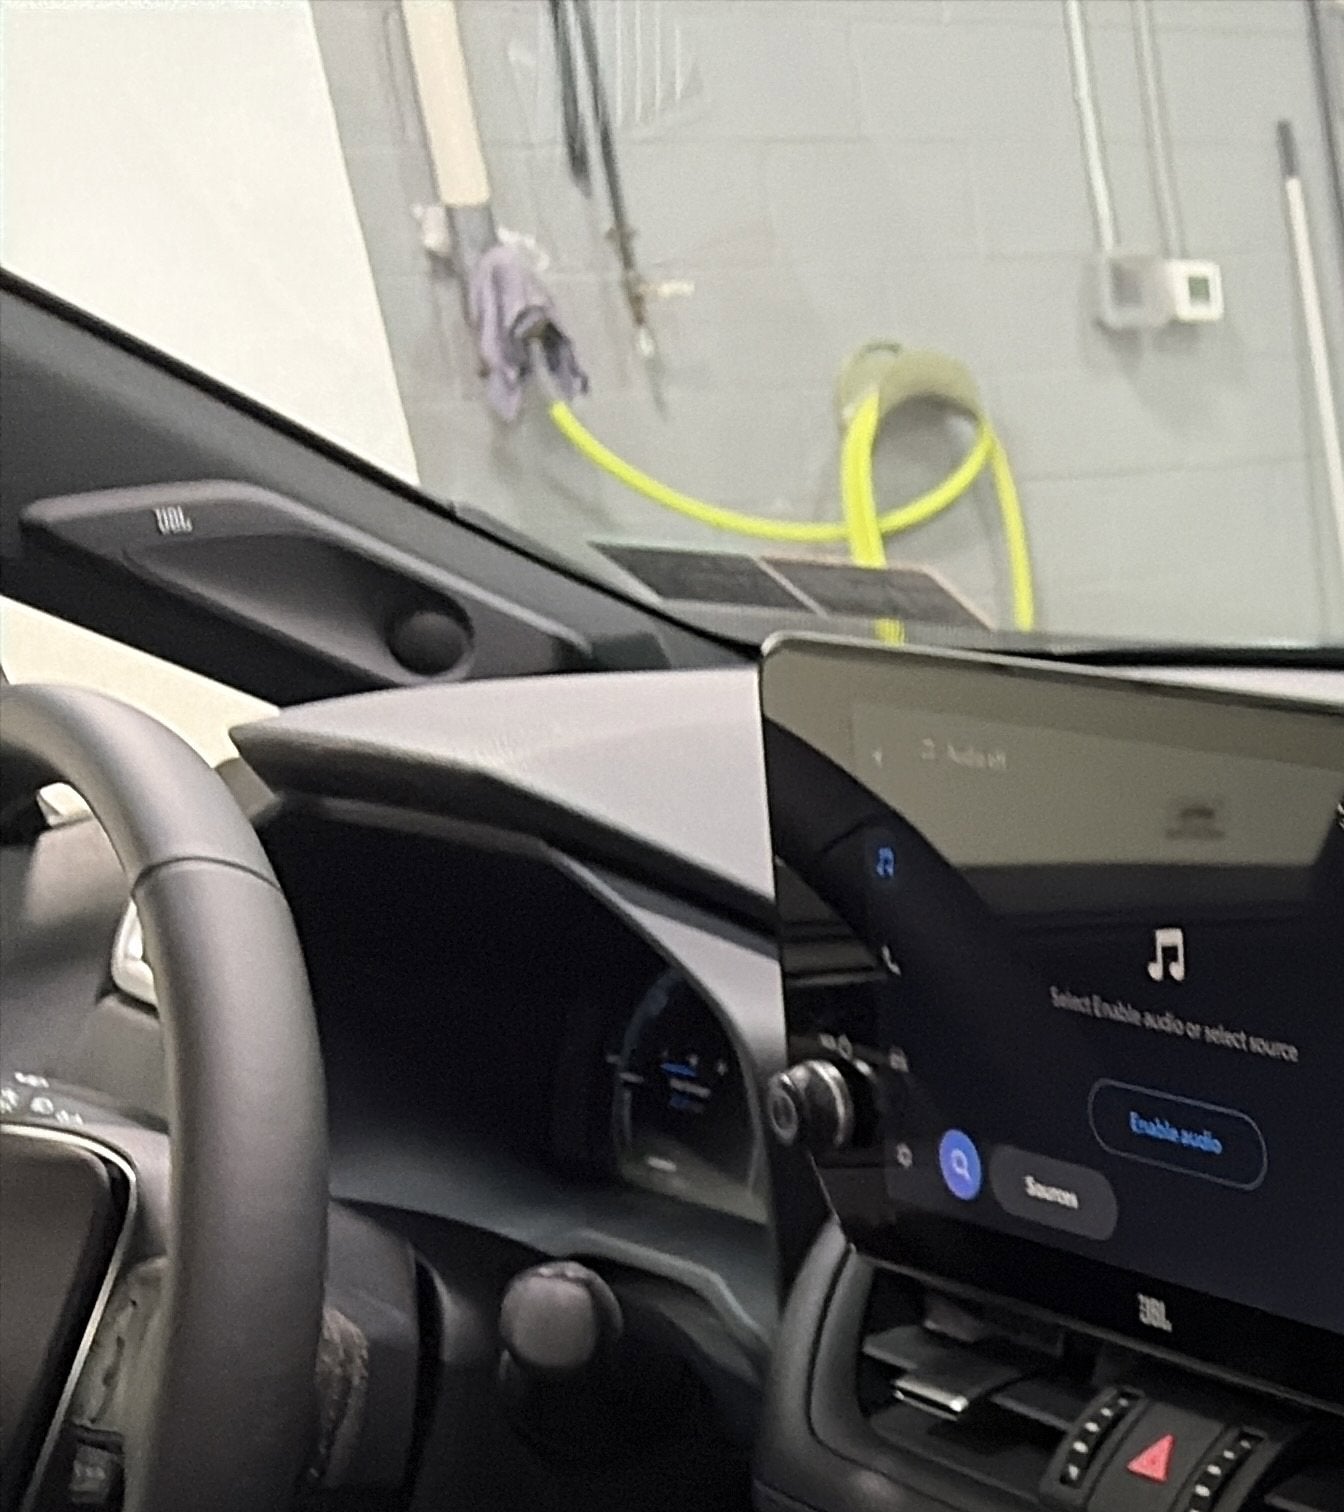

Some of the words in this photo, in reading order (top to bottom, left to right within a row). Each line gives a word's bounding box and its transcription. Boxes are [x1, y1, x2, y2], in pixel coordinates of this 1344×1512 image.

[1050, 986, 1092, 1016] Select
[1092, 995, 1142, 1026] Enable
[1142, 1011, 1185, 1036] audio
[1185, 1021, 1202, 1039] or
[1203, 1024, 1249, 1051] select
[1249, 1036, 1299, 1062] source
[1129, 1111, 1180, 1143] Enable
[1180, 1129, 1223, 1155] audio
